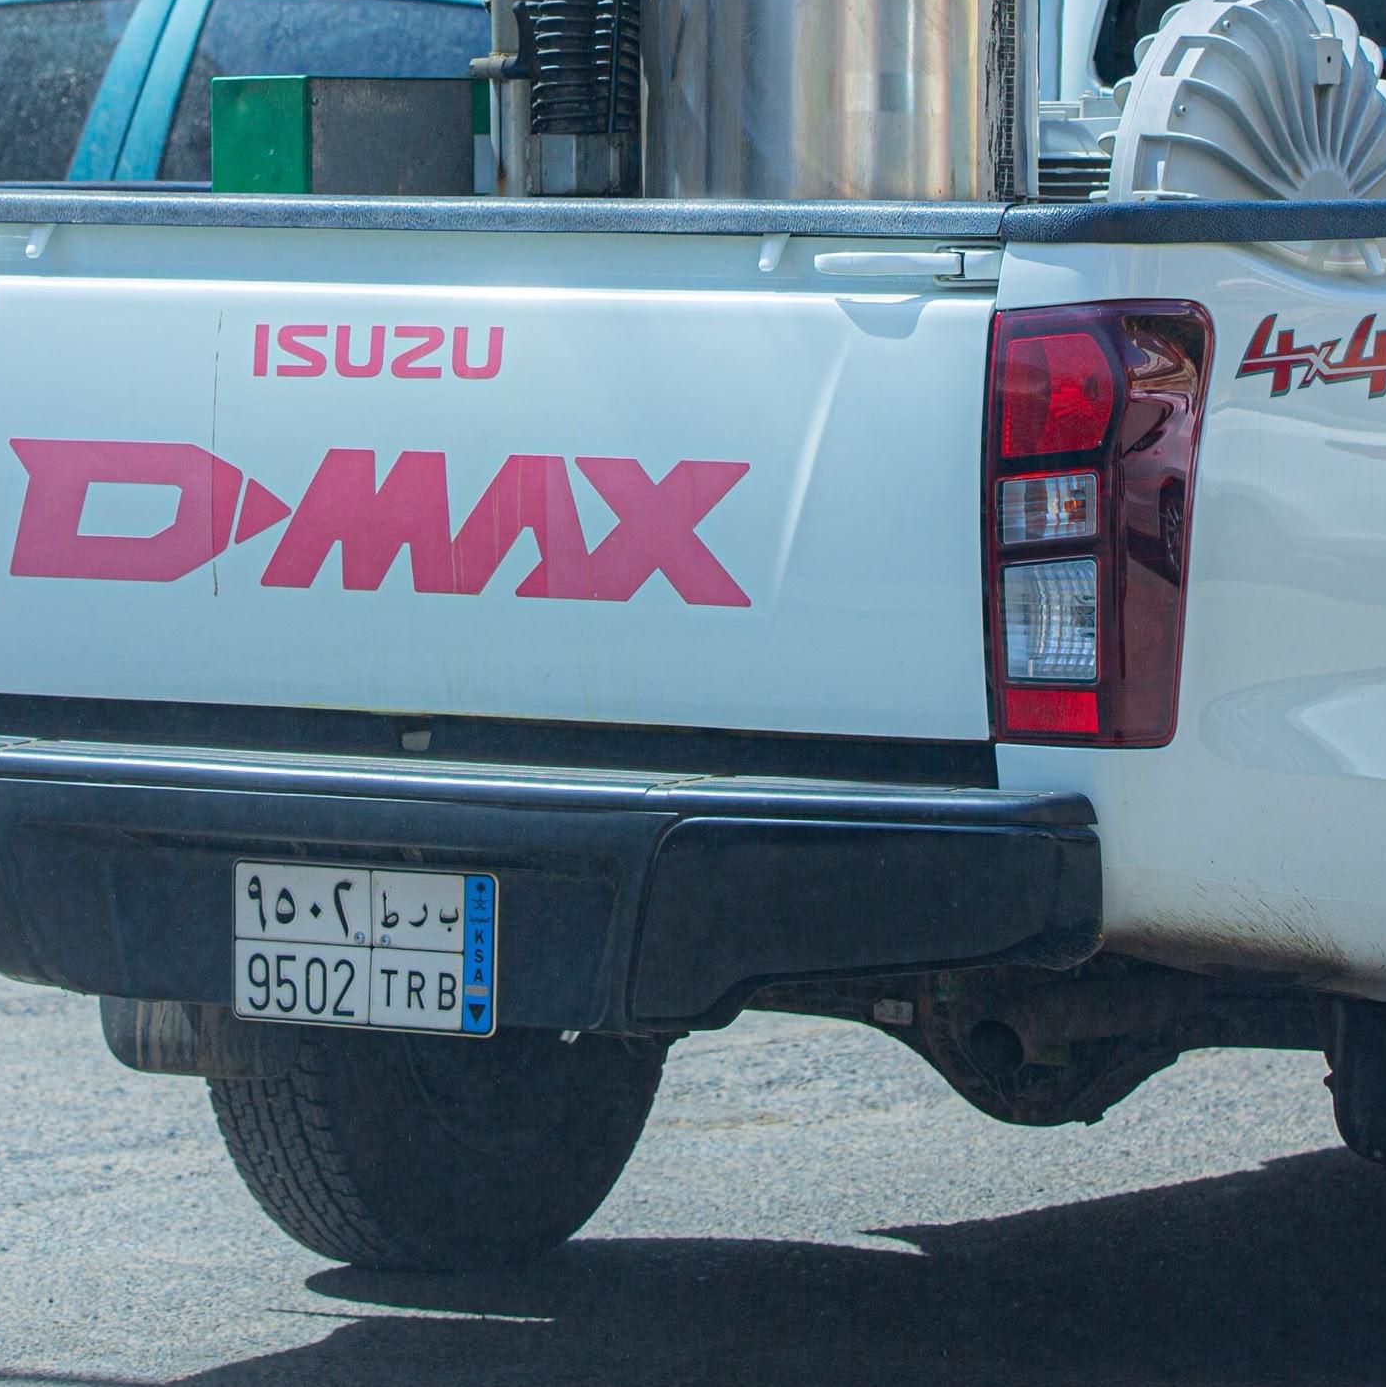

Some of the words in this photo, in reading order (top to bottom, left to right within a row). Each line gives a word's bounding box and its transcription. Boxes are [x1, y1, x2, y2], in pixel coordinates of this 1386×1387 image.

[253, 323, 505, 380] ISUZU
[9, 438, 752, 607] D-MAX
[248, 952, 355, 1018] 9502
[380, 968, 458, 1012] TRB
